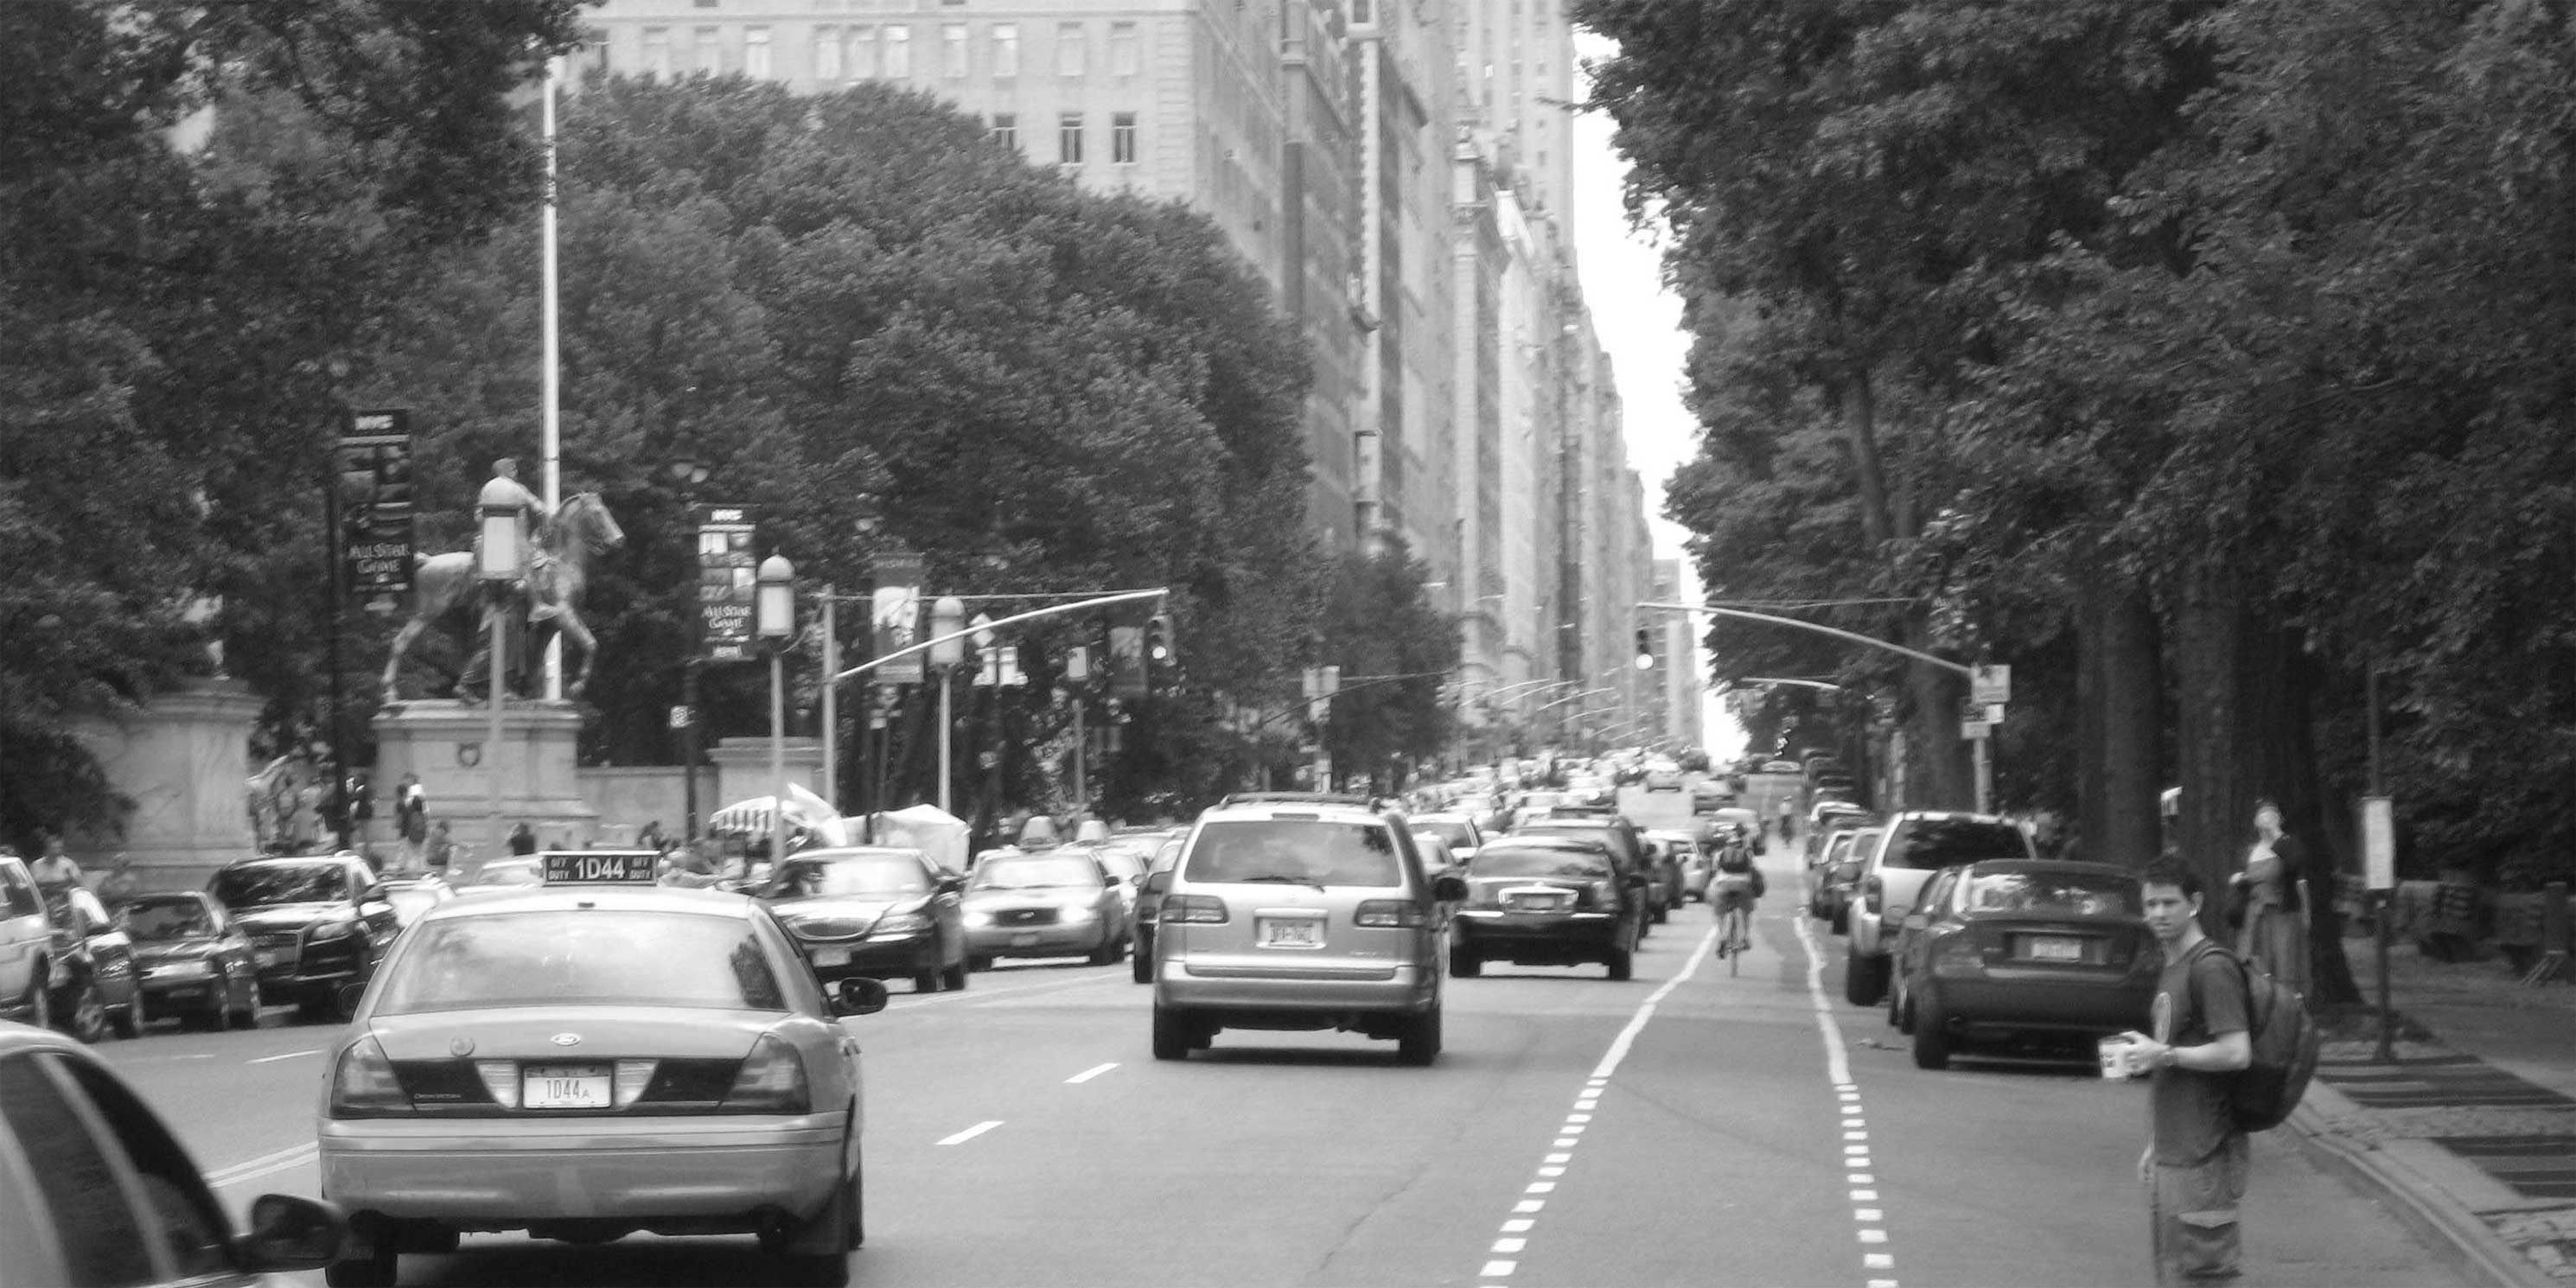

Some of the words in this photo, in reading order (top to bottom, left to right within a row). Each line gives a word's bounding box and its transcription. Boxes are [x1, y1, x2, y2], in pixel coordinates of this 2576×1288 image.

[575, 857, 625, 880] 1D44
[548, 870, 571, 880] DUTY
[629, 870, 653, 880] DUTY
